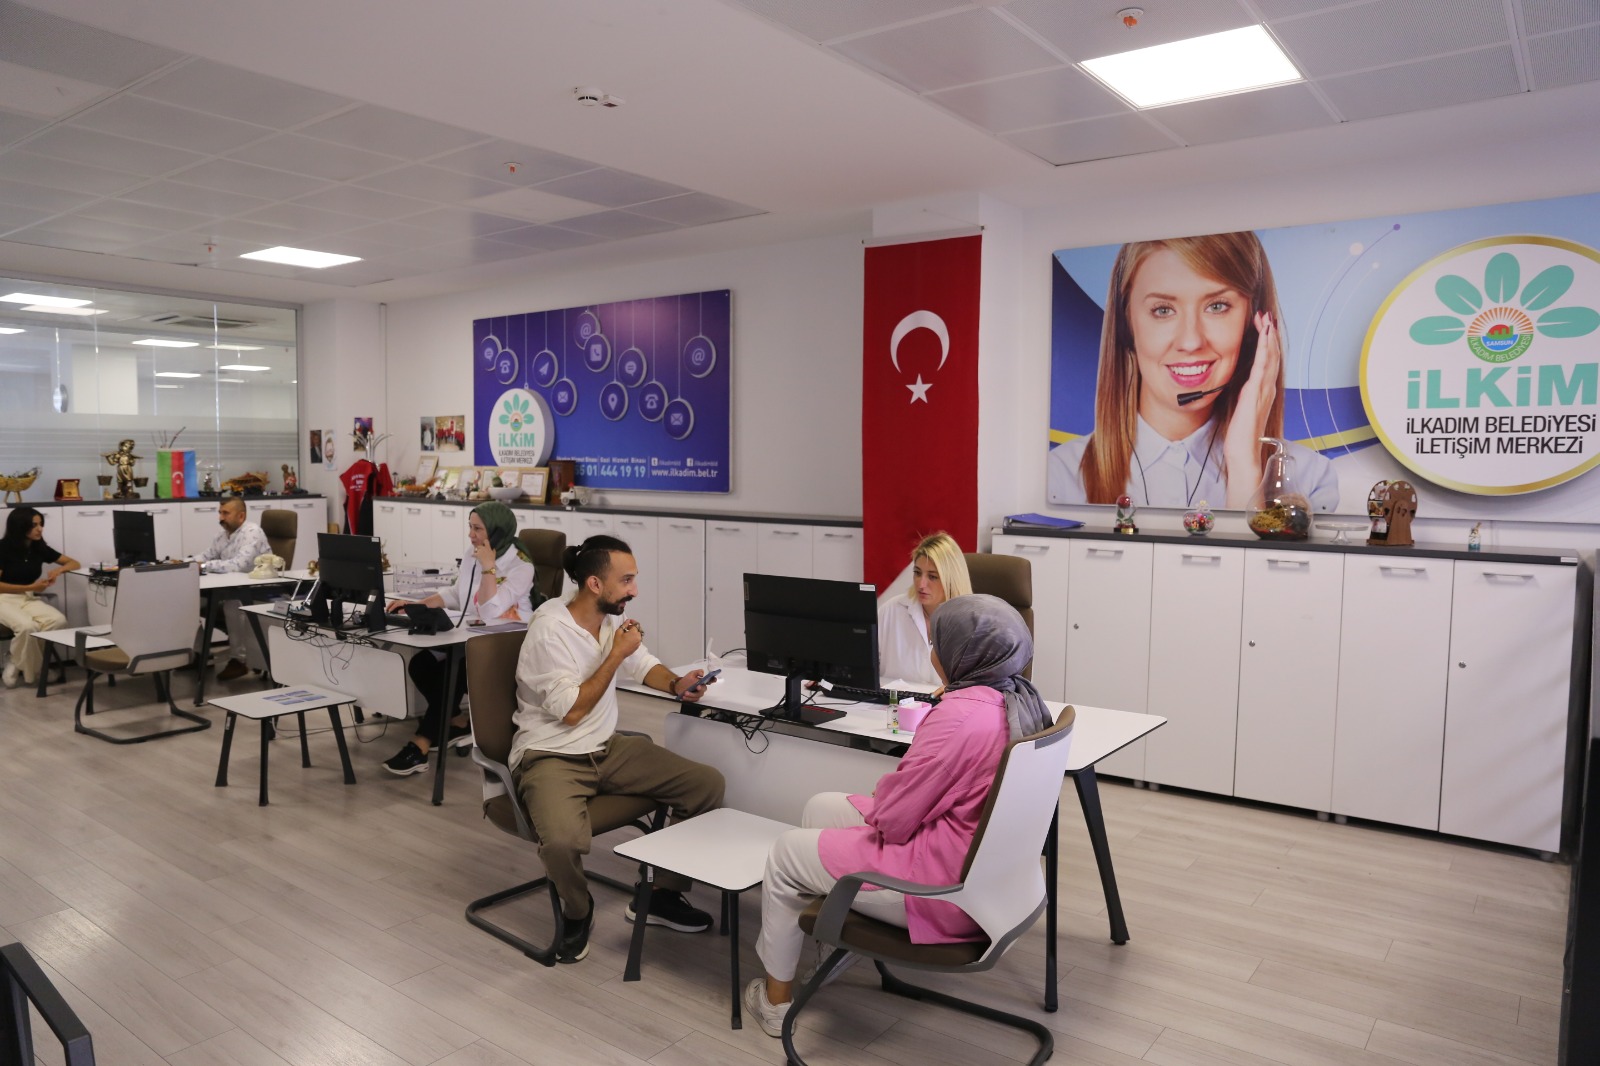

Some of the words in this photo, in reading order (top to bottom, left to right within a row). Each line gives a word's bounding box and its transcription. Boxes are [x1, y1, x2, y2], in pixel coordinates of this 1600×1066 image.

[600, 465, 618, 477] 444
[620, 465, 631, 477] 19
[634, 466, 646, 477] 19
[651, 468, 718, 478] www.ilkadim.bel.tr
